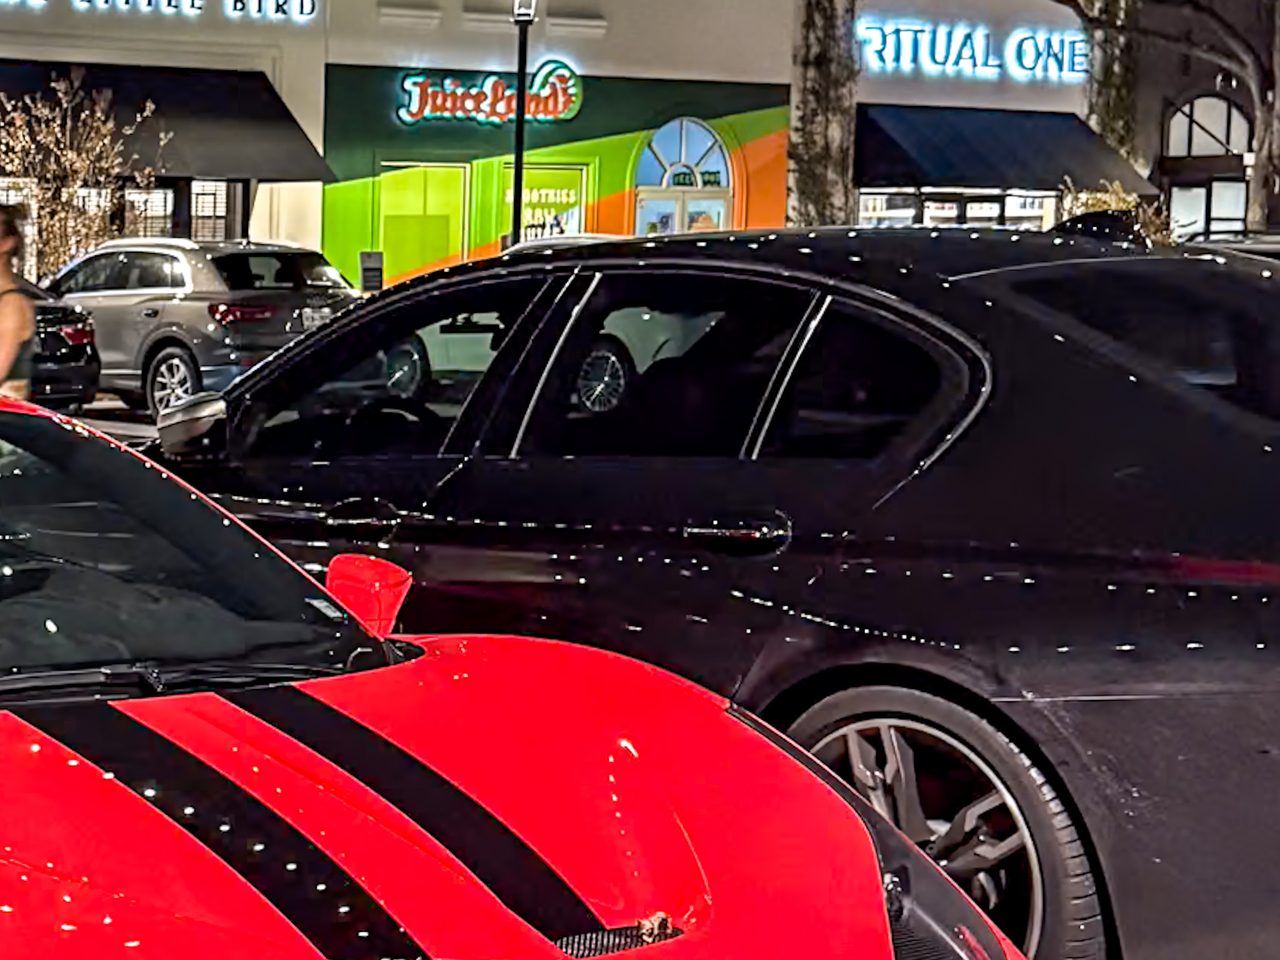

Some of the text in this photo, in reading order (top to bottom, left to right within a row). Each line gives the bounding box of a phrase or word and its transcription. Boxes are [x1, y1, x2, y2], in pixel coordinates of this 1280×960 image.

[863, 25, 1090, 74] RITUAL ONE
[505, 188, 576, 204] SOOTHIES
